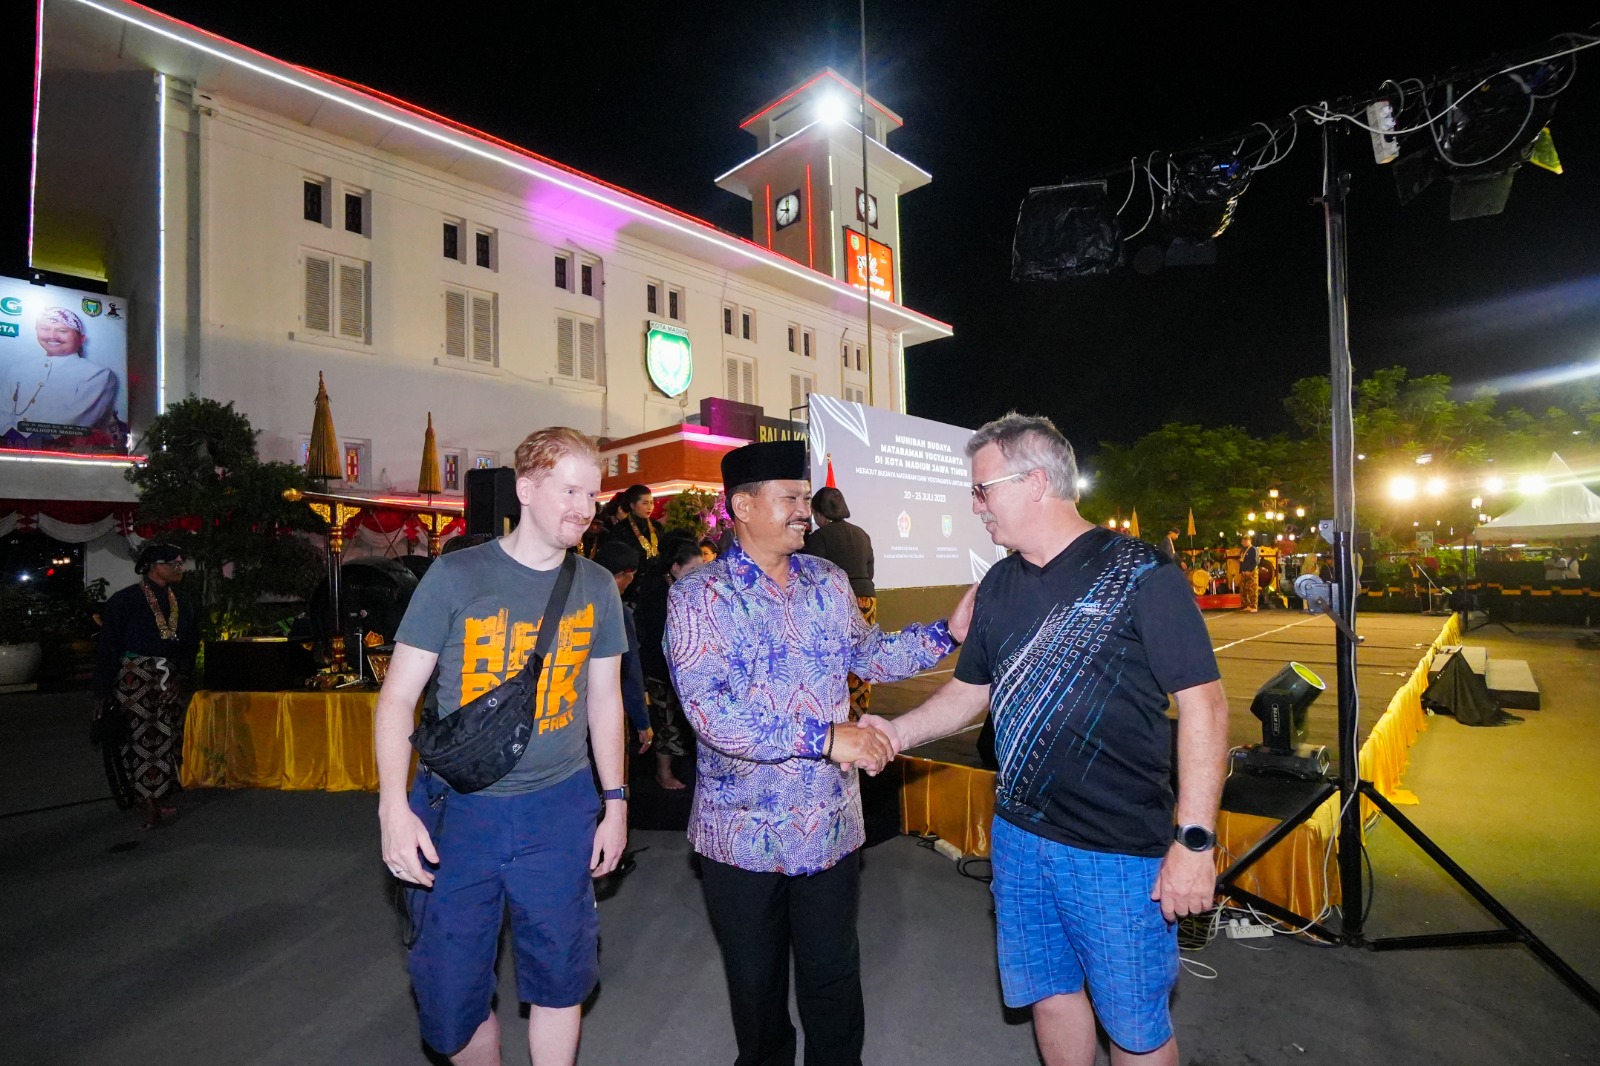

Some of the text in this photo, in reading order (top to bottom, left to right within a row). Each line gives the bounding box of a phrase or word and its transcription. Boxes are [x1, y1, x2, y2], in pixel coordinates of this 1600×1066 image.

[0, 324, 15, 334] TA
[651, 322, 666, 330] KOTA
[895, 434, 952, 453] MUHIBAH BUDAYA
[880, 444, 964, 466] MATARAMAN YOGYAKARTA
[874, 455, 968, 477] DI KOTA MADIUN JAWA TIMUR
[903, 490, 912, 499] 20
[922, 492, 934, 502] JULI
